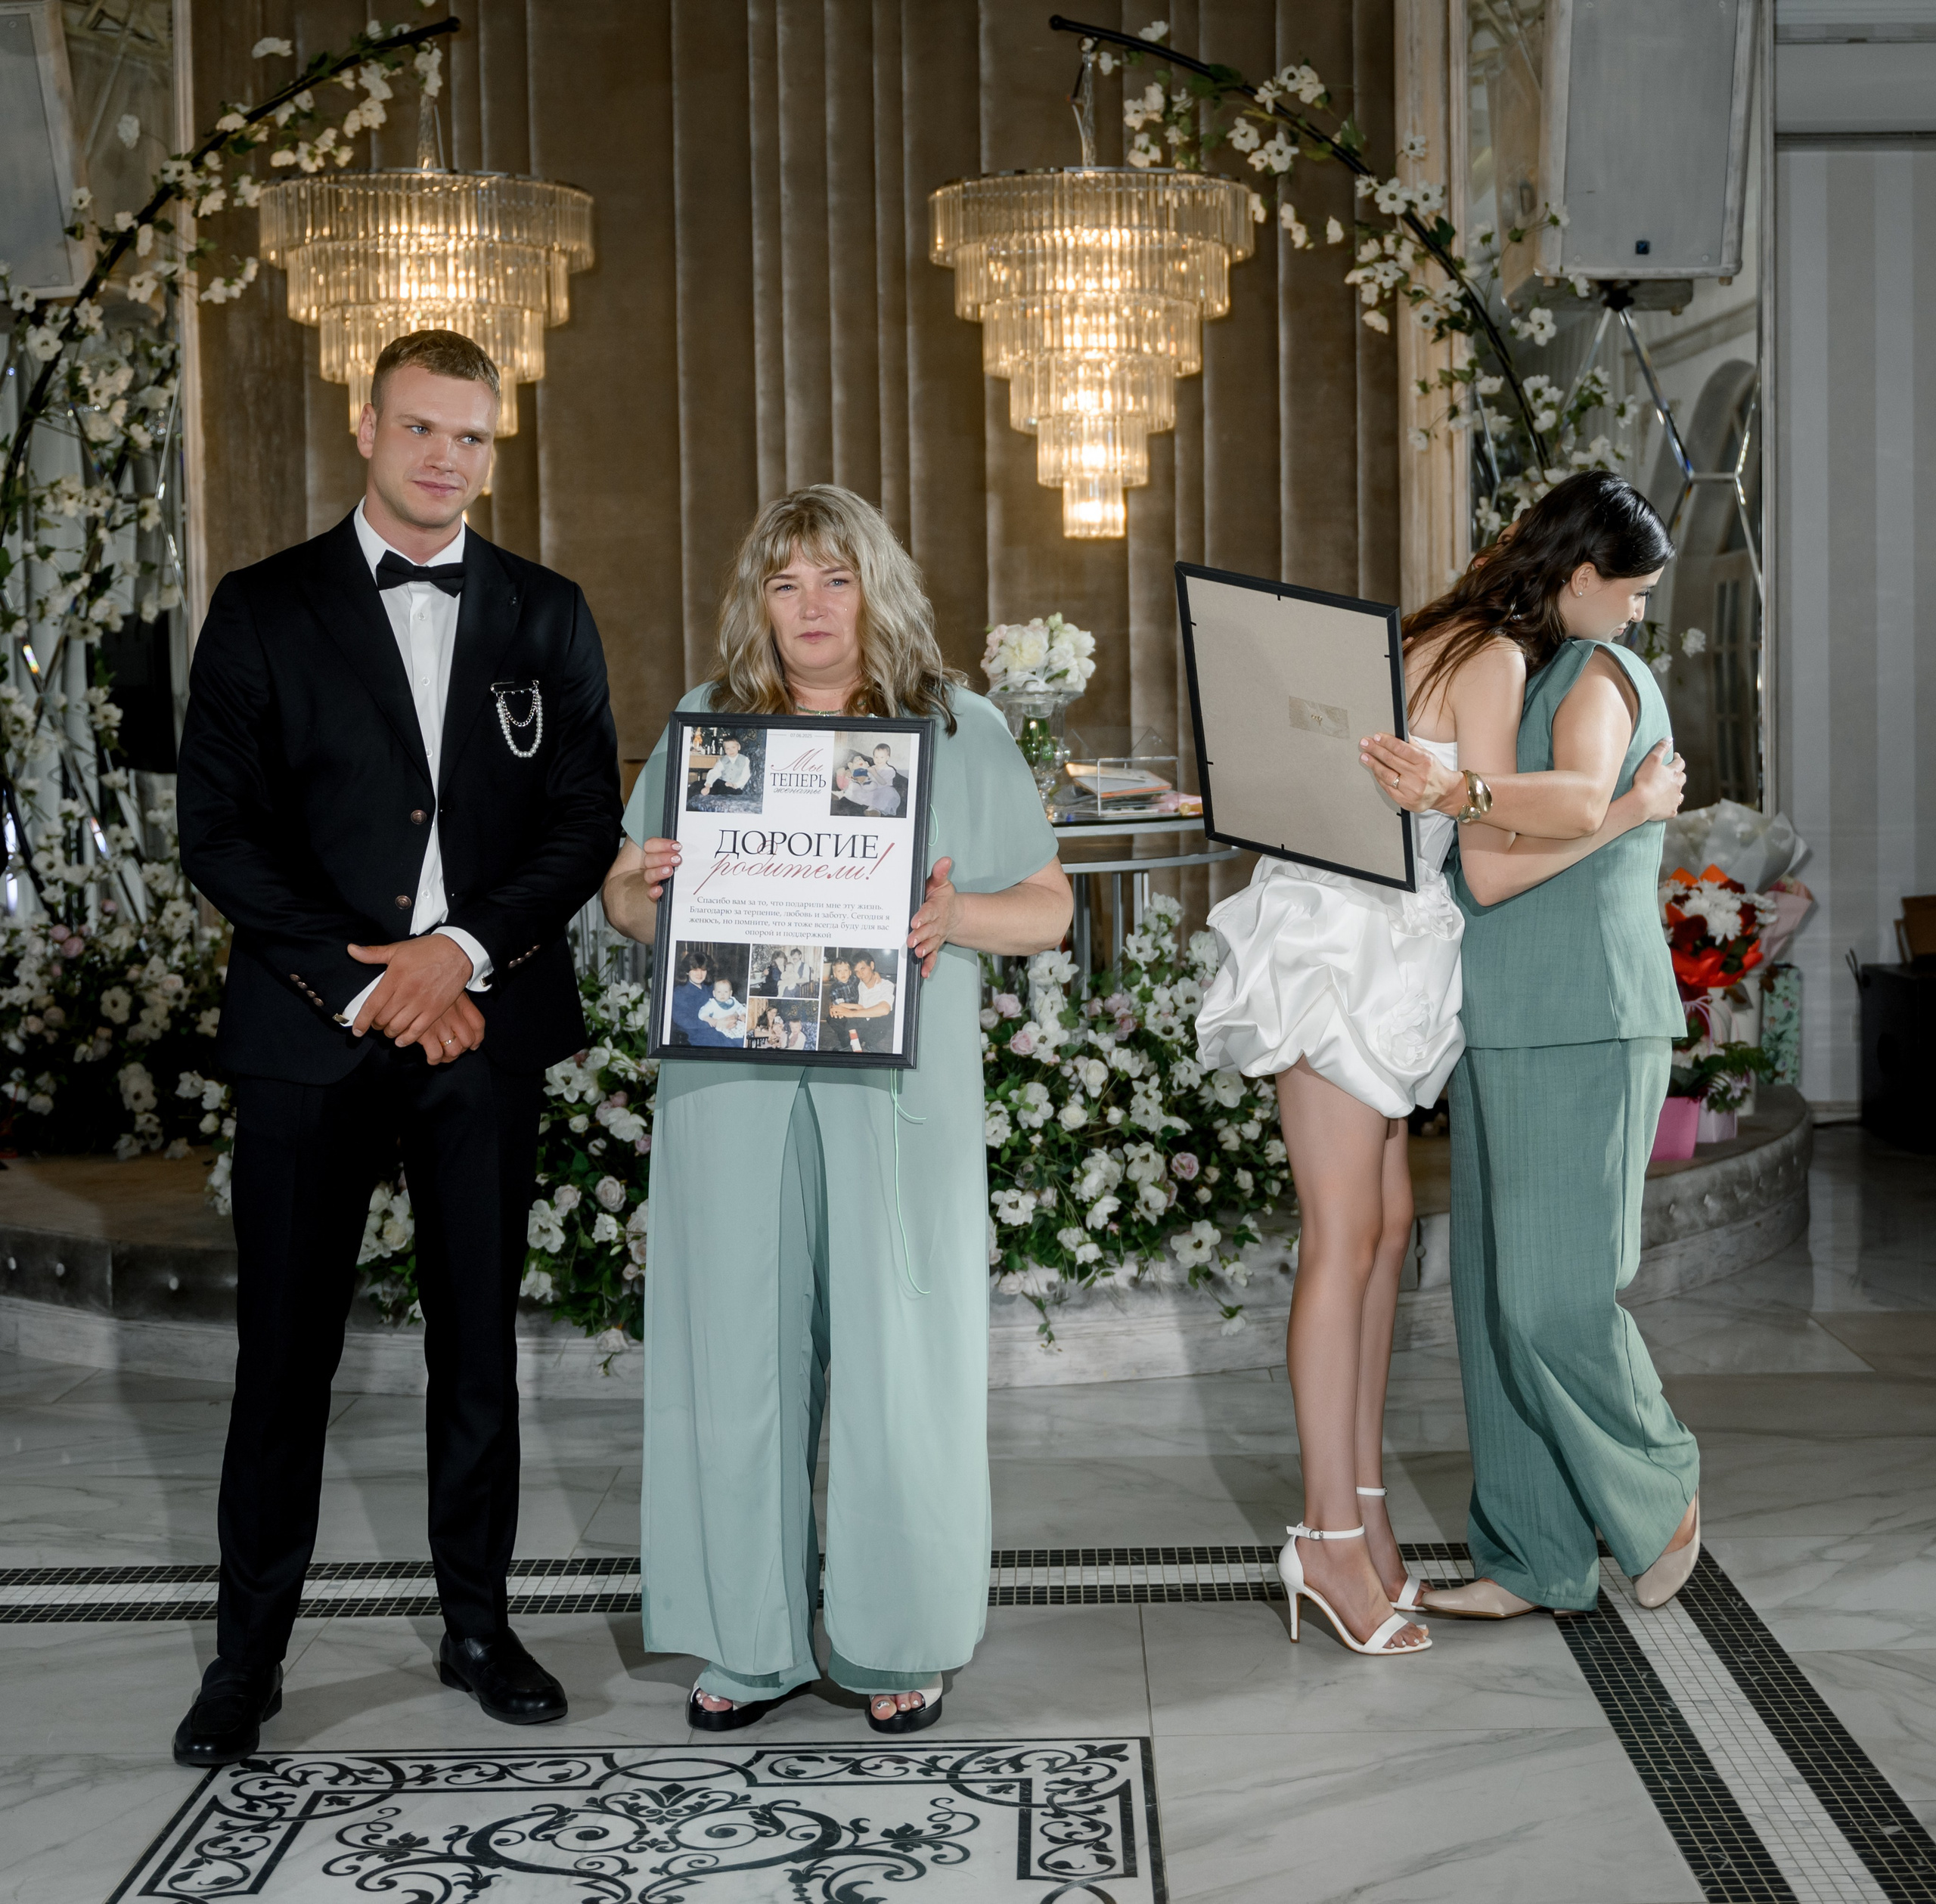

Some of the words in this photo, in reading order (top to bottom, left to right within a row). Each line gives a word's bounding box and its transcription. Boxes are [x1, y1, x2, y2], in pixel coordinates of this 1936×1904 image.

[770, 748, 824, 772] Мы
[770, 773, 827, 788] ТЕПЕРЬ
[714, 829, 879, 860] ДОРОГИЕ
[693, 842, 895, 895] родители!
[697, 896, 731, 905] Спасибо
[785, 901, 824, 910] подарили
[843, 904, 855, 912] эту
[690, 906, 733, 916] Благодарю
[743, 910, 782, 918] терпение,
[783, 910, 813, 918] любовь
[821, 911, 849, 920] заботу.
[851, 912, 883, 921] Сегодня
[689, 916, 721, 925] женюсь,
[734, 919, 771, 927] помните,
[840, 921, 860, 932] буду
[745, 928, 774, 938] опорой
[783, 931, 831, 940] поддержкой
